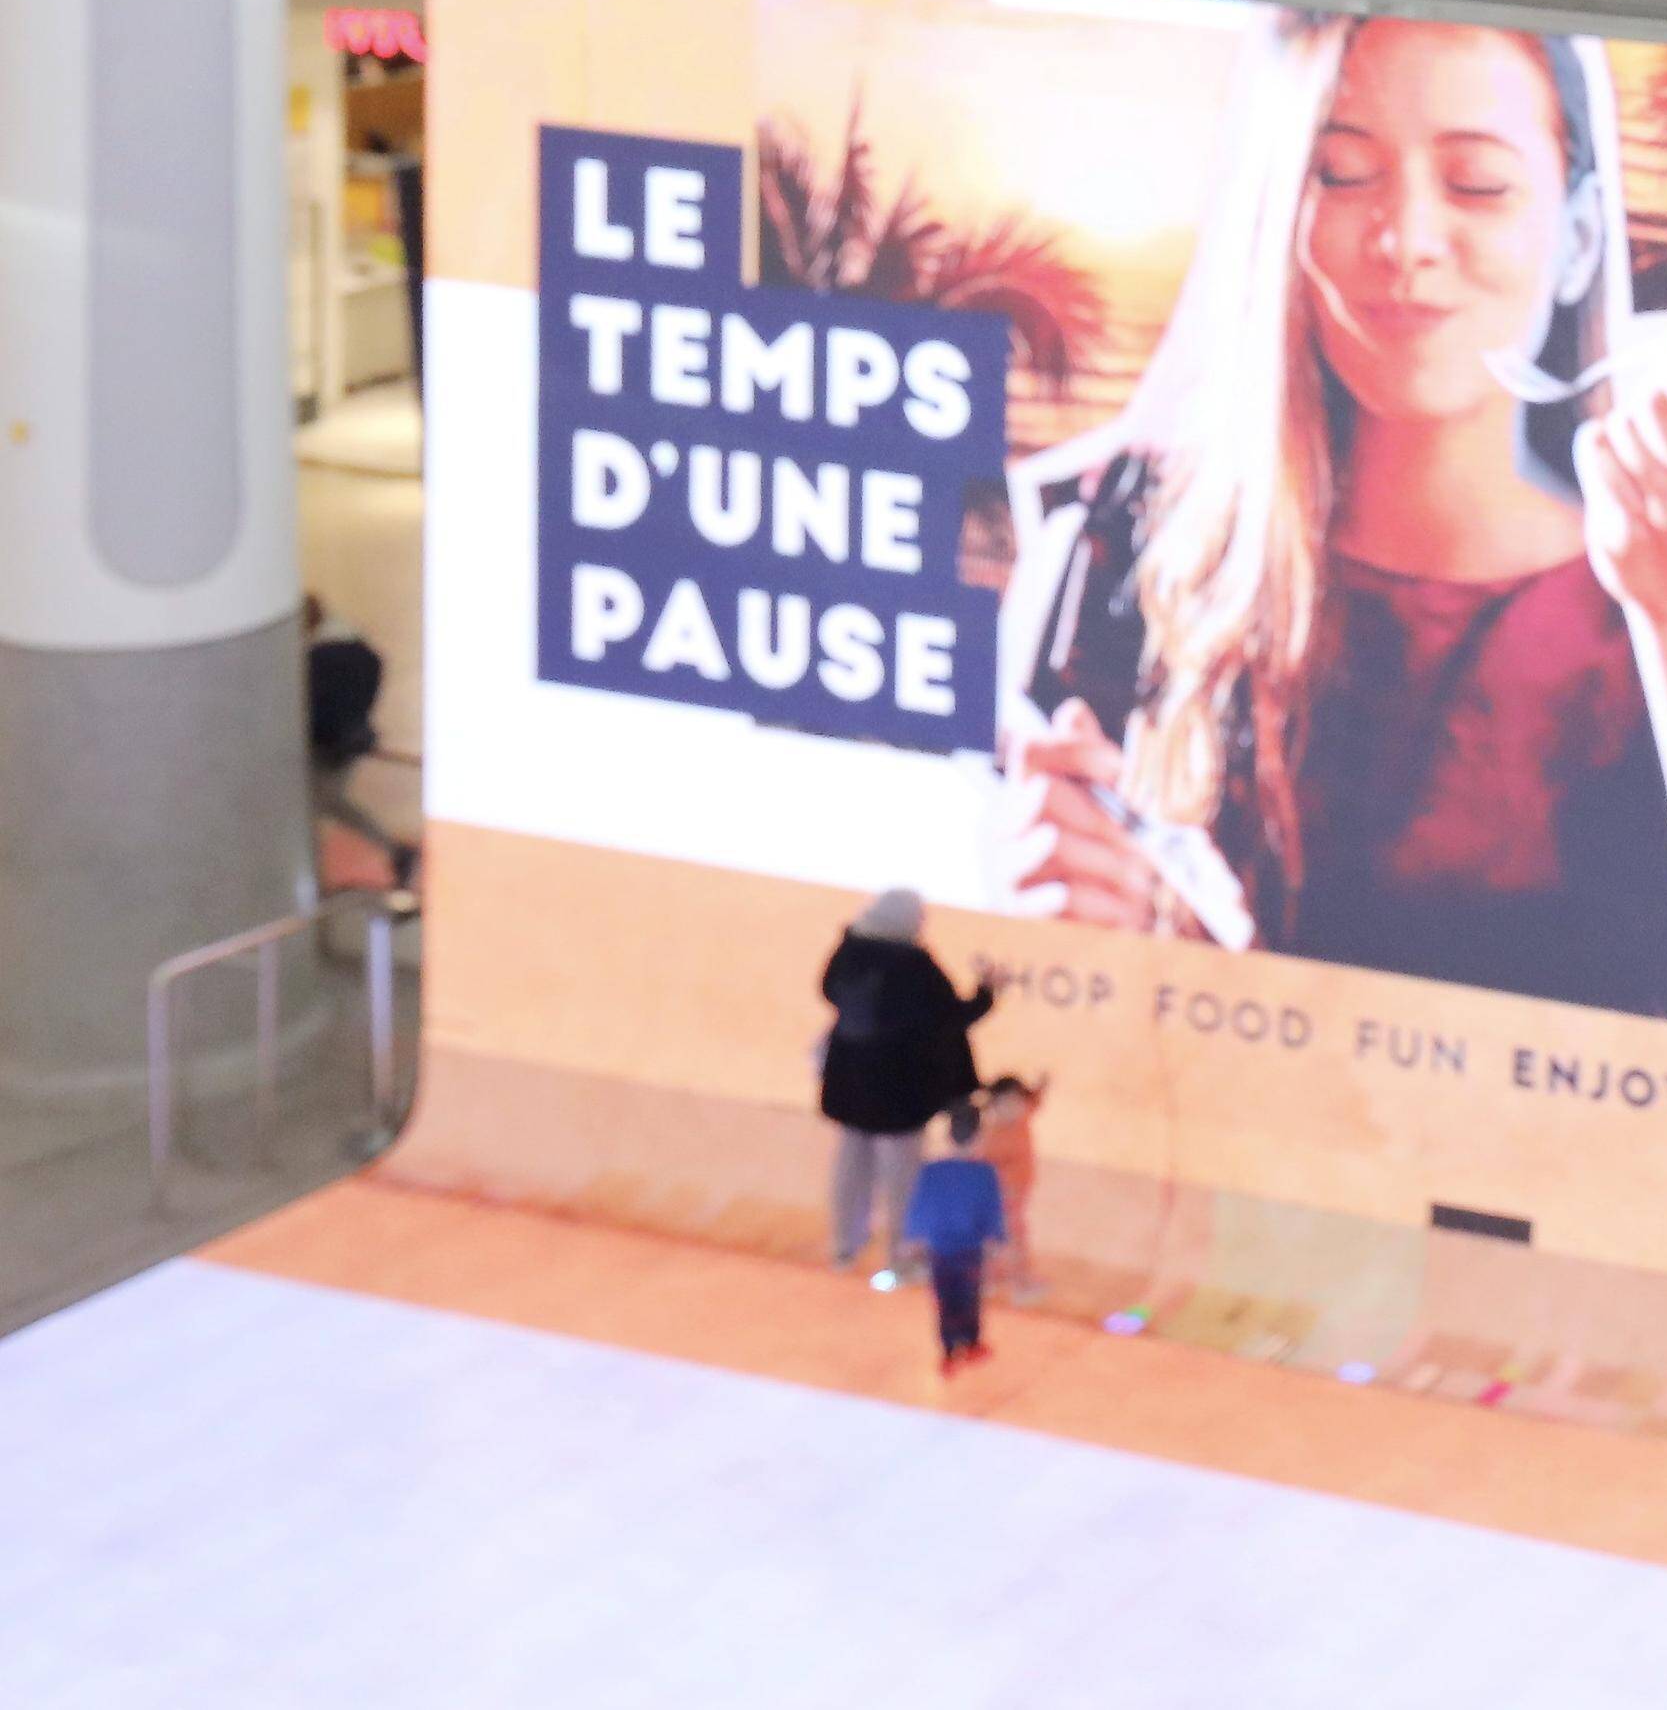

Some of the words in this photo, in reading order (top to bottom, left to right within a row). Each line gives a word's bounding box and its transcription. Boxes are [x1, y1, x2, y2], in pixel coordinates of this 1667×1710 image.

[573, 158, 706, 269] LE
[569, 292, 973, 440] TEMPS
[571, 427, 923, 575] D'UNE
[571, 561, 957, 717] PAUSE
[1155, 986, 1312, 1049] FOOD
[1355, 1018, 1466, 1073] FUN
